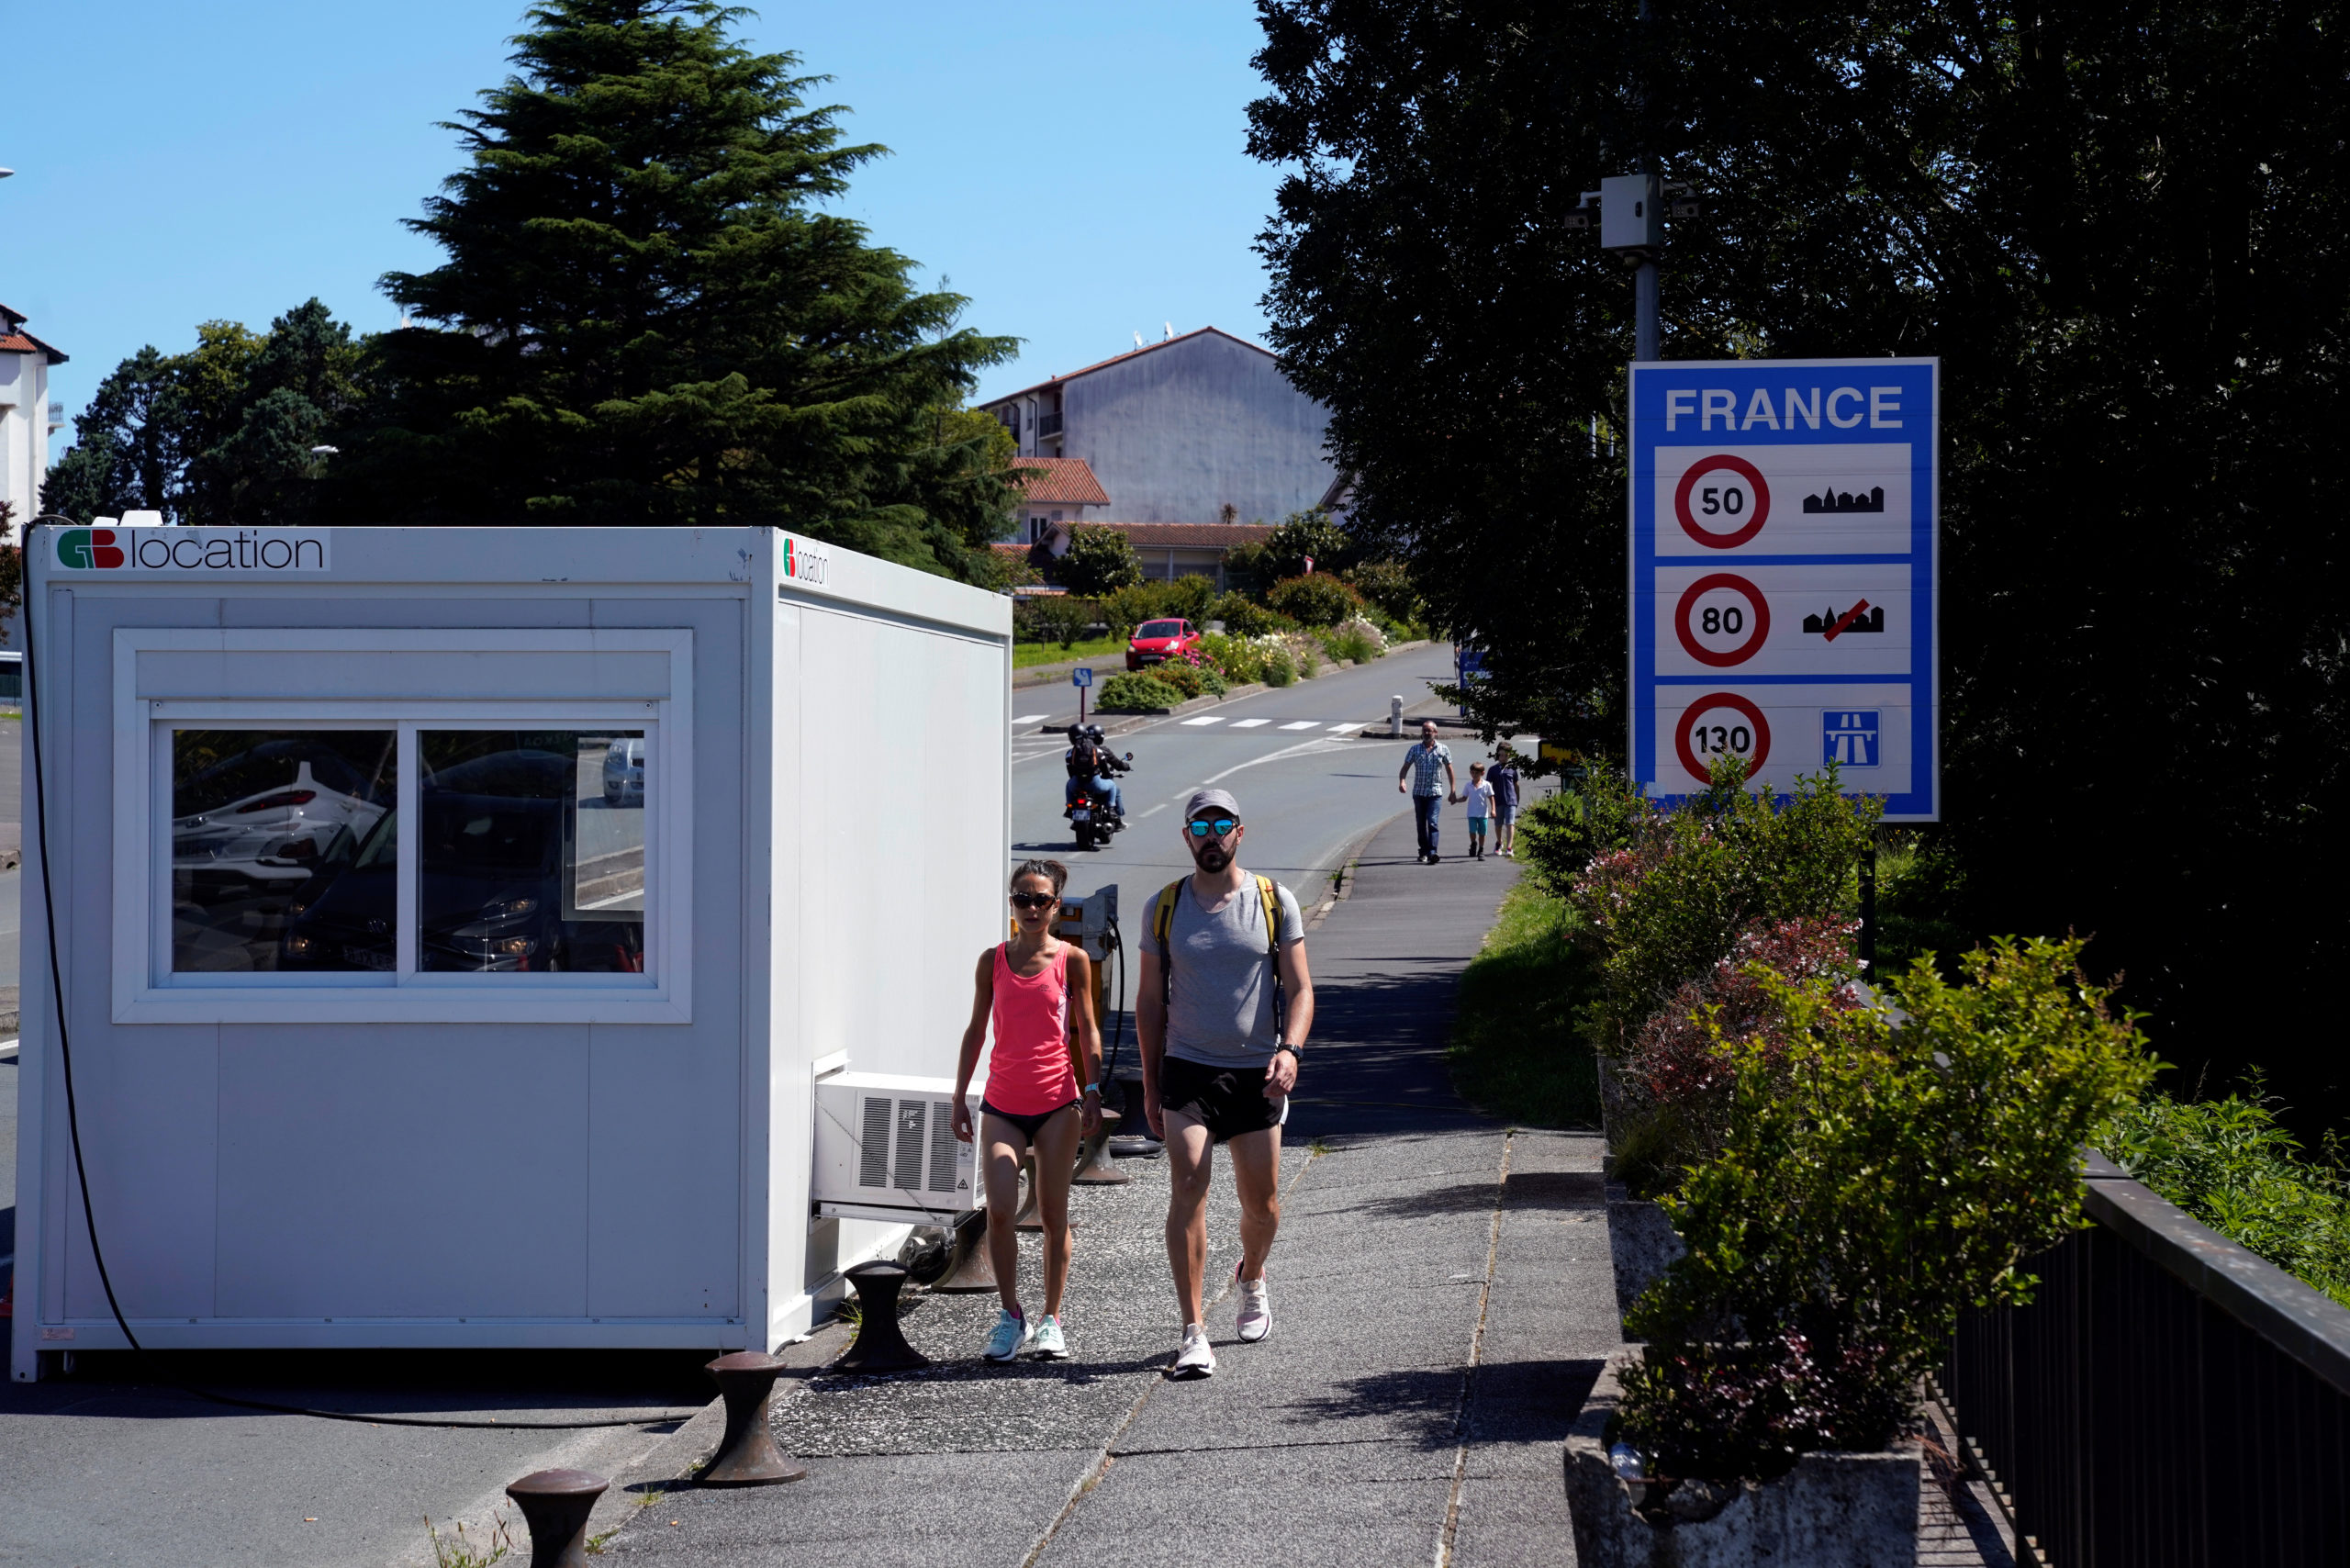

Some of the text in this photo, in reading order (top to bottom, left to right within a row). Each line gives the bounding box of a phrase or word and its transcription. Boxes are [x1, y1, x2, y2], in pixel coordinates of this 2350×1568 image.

[1665, 386, 1903, 432] FRANCE
[1701, 487, 1744, 516] 50
[131, 529, 324, 569] location
[796, 540, 829, 587] location
[1701, 606, 1744, 635] 80
[1695, 725, 1751, 755] 130
